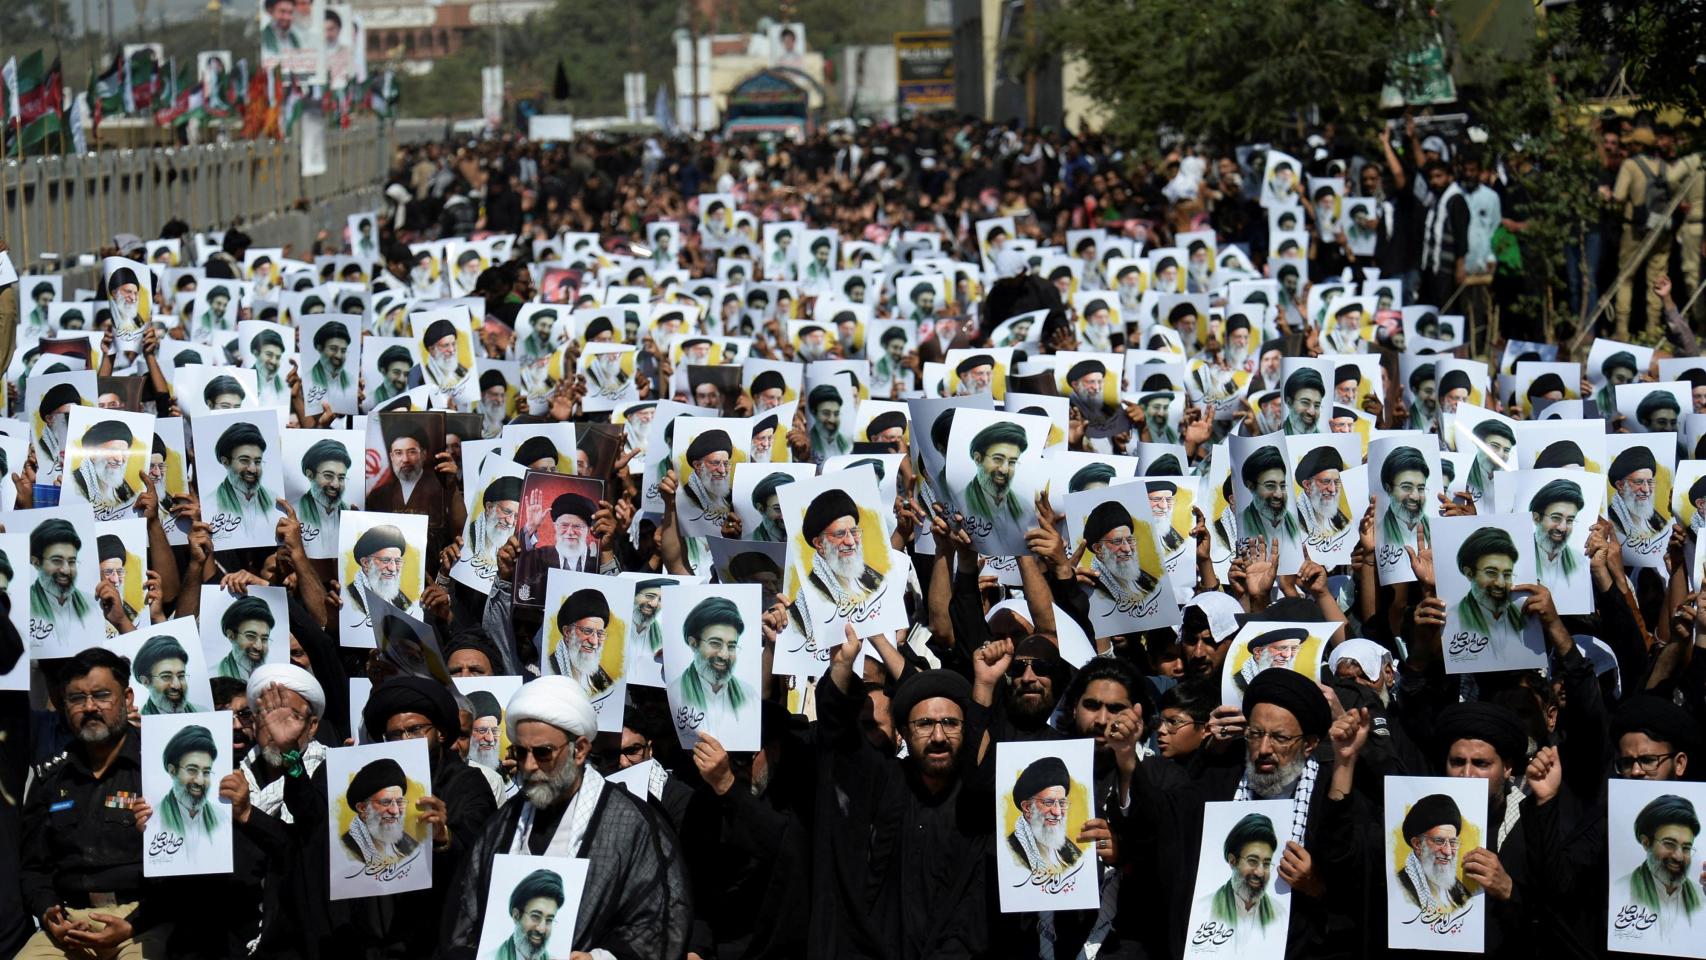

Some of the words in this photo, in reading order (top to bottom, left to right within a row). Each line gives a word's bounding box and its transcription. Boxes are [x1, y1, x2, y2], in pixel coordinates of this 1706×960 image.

[224, 513, 242, 532] صالح
[1450, 632, 1468, 654] صالح
[1469, 632, 1488, 652] صالح
[676, 706, 688, 730] صالح
[690, 707, 704, 729] صالح
[149, 831, 167, 856] صالح
[166, 832, 184, 854] صالح
[1615, 905, 1637, 929] صالح
[1636, 907, 1658, 930] صالح
[1193, 921, 1216, 944] صالح
[1213, 923, 1234, 945] صالح
